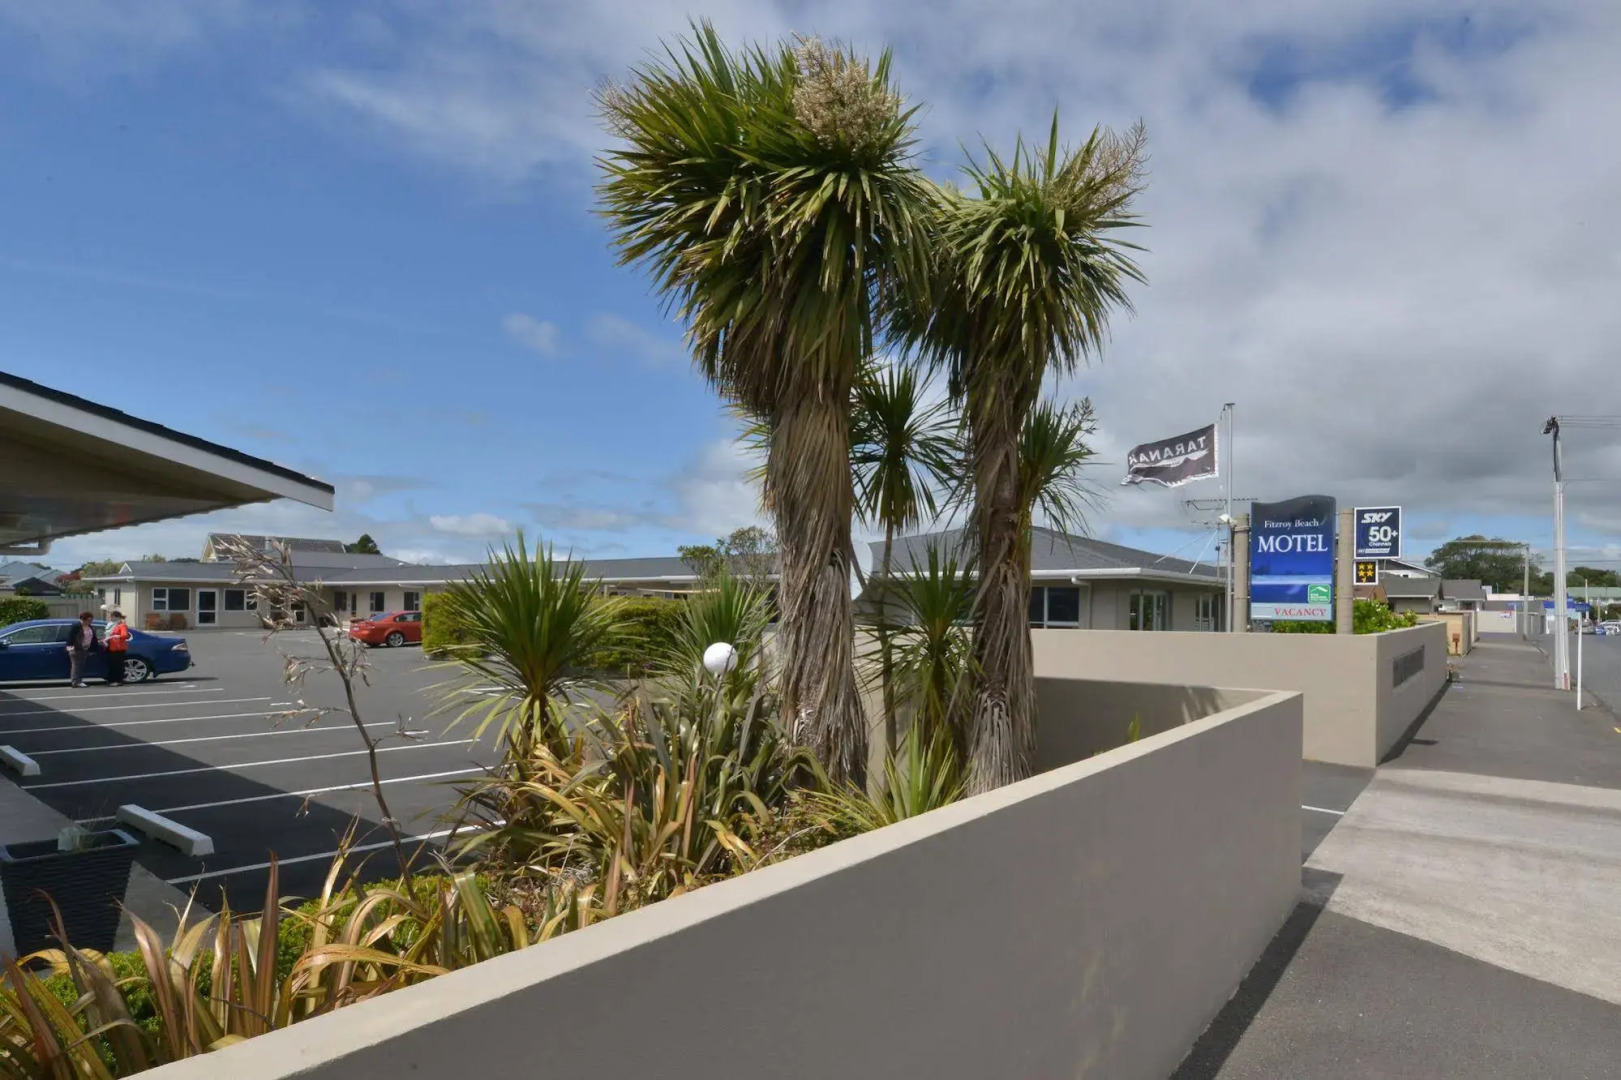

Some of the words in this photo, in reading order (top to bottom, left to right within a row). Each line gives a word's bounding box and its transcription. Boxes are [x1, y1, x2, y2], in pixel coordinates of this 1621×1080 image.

[1264, 520, 1292, 530] Fitzroy
[1294, 518, 1319, 528] Beach
[1361, 512, 1393, 524] SKY
[1368, 525, 1398, 542] 50+
[1257, 534, 1328, 553] MOTEL
[1274, 607, 1327, 617] VACANCY
